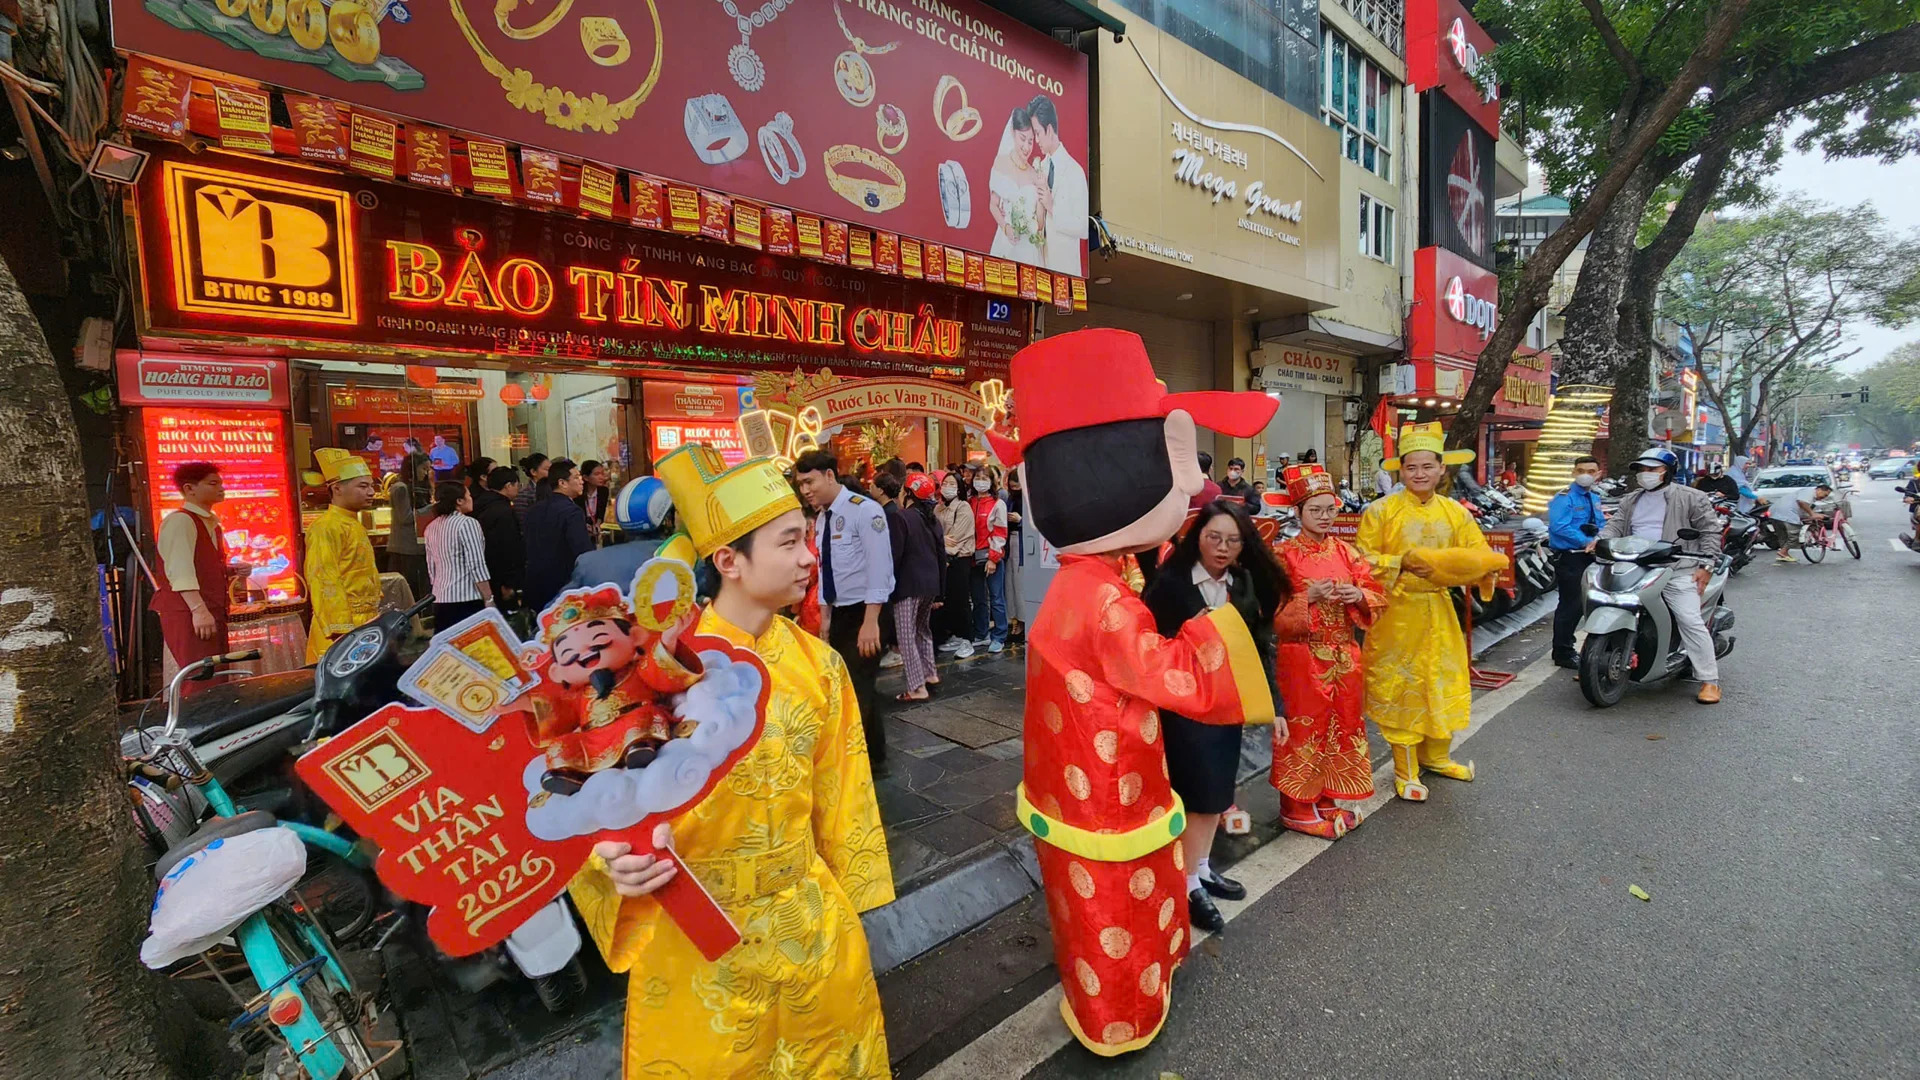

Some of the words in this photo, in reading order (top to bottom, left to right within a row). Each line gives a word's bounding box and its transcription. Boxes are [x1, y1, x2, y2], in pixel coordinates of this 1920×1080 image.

[965, 14, 1005, 47] LONG
[858, 0, 913, 31] TRANG
[916, 18, 948, 45] SỨC
[950, 33, 988, 64] CHẤT
[989, 49, 1036, 85] LƯỢNG
[1036, 73, 1064, 97] CAO
[247, 109, 266, 118] LONG
[376, 136, 393, 146] LONG
[1172, 148, 1239, 205] Mega
[1244, 181, 1303, 223] Grand
[1238, 217, 1274, 238] INSTITUTE
[1277, 231, 1301, 247] CLINIC
[563, 230, 612, 251] CÔNG
[641, 245, 682, 264] TNHH
[687, 250, 726, 271] VÀNG
[203, 280, 272, 303] BTMC
[279, 288, 334, 308] 1989
[386, 229, 555, 316] BẢO
[570, 259, 688, 330] TÍN
[700, 285, 846, 346] MINH
[852, 303, 965, 358] CHÂU
[992, 302, 1008, 319] 29
[1463, 293, 1497, 341] DOJI
[377, 315, 412, 331] KINH
[415, 319, 466, 336] DOANH
[470, 323, 508, 339] VÀNG
[180, 364, 209, 373] BTMC
[211, 365, 233, 374] 1989
[1278, 368, 1294, 379] CHÁO
[1295, 370, 1305, 381] TIM
[1283, 351, 1323, 370] CHÁO
[1325, 358, 1340, 373] 37
[145, 369, 201, 386] HOÀNG
[202, 373, 232, 387] KIM
[157, 388, 184, 396] PURE
[186, 389, 213, 398] GOLD
[216, 390, 257, 398] JEWELRY
[677, 395, 703, 406] THĂNG
[703, 398, 724, 407] LONG
[827, 393, 863, 414] Rước
[867, 391, 891, 408] Lộc
[895, 388, 928, 408] Vàng
[963, 400, 980, 418] Tài
[369, 783, 396, 804] BTMC
[396, 768, 419, 788] 1989
[392, 785, 465, 834] VÍA
[398, 794, 505, 875] THẦN
[443, 833, 509, 886] TÀI
[456, 849, 545, 922] 2026
